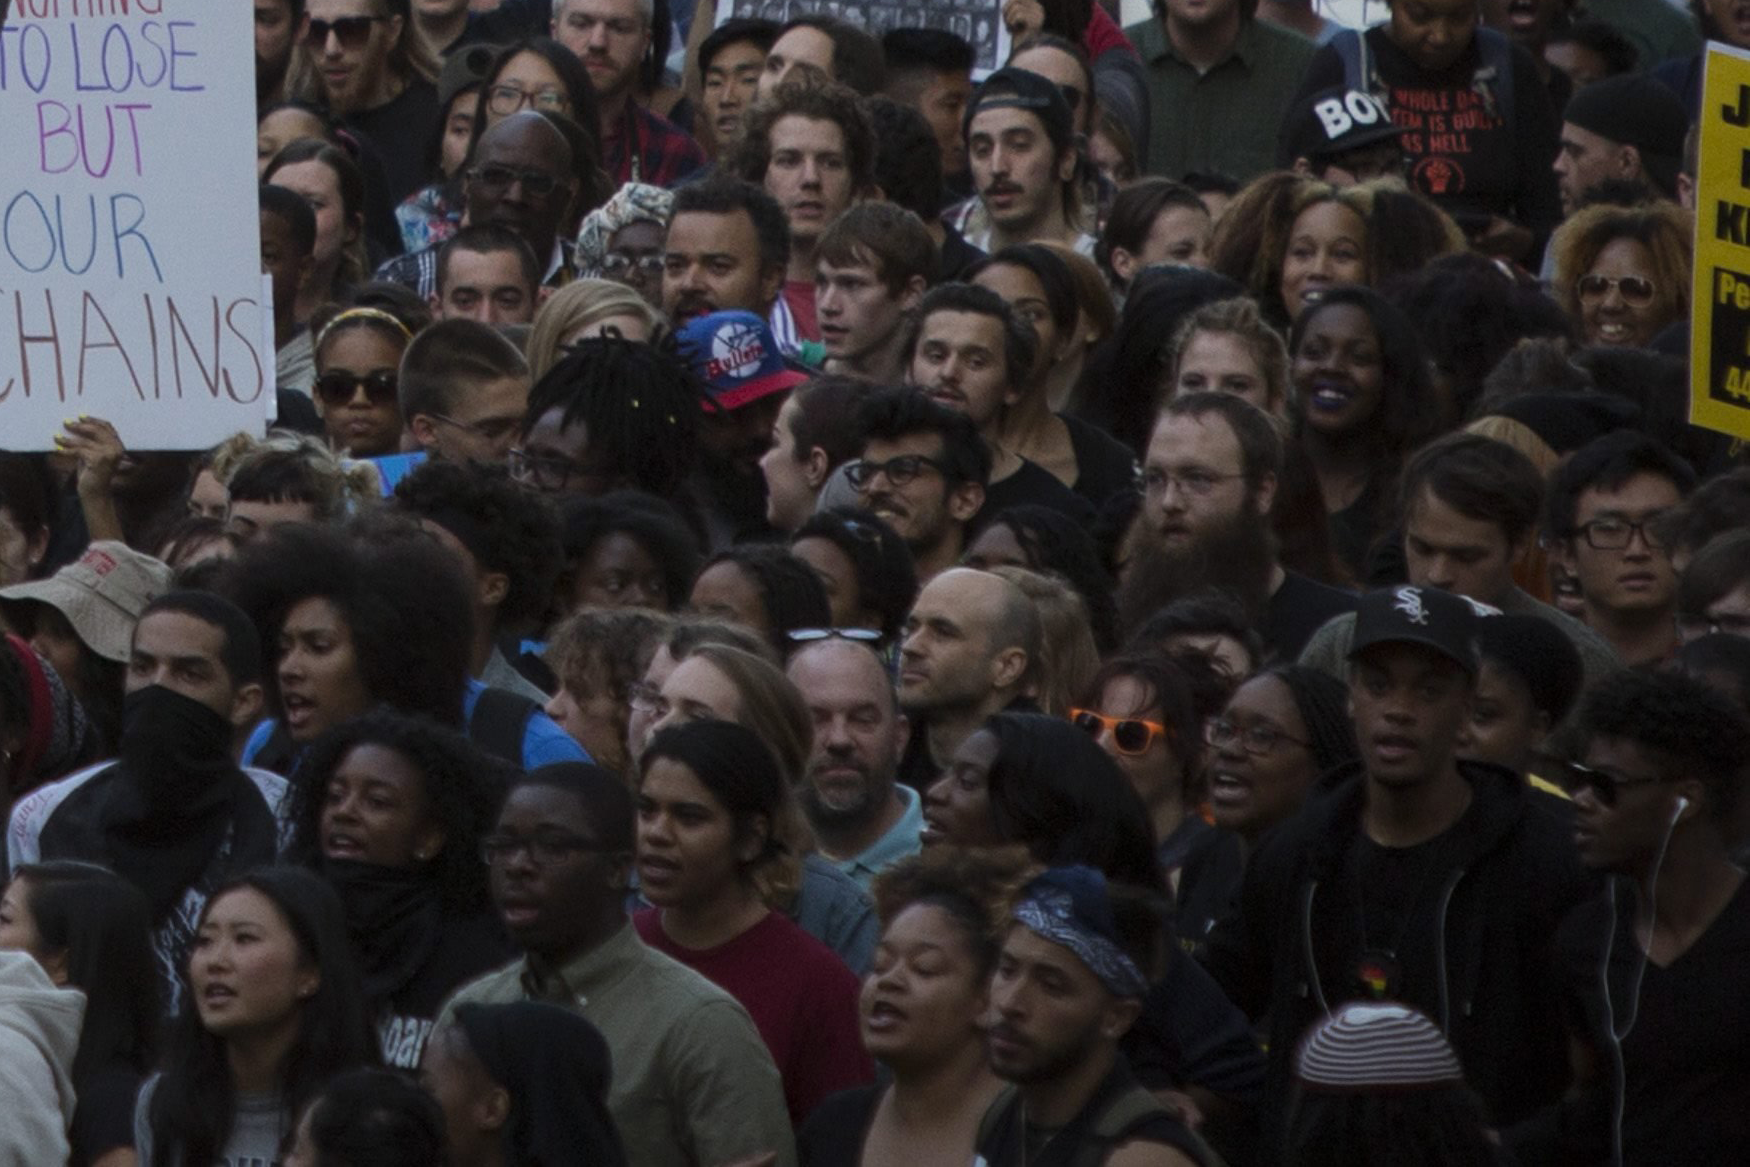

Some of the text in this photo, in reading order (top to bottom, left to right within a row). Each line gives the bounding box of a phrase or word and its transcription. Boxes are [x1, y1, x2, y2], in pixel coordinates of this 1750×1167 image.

[69, 21, 207, 94] LOSE
[37, 100, 154, 178] BUT
[1428, 113, 1447, 132] IS
[1429, 133, 1472, 154] HELL
[3, 189, 163, 284] OUR
